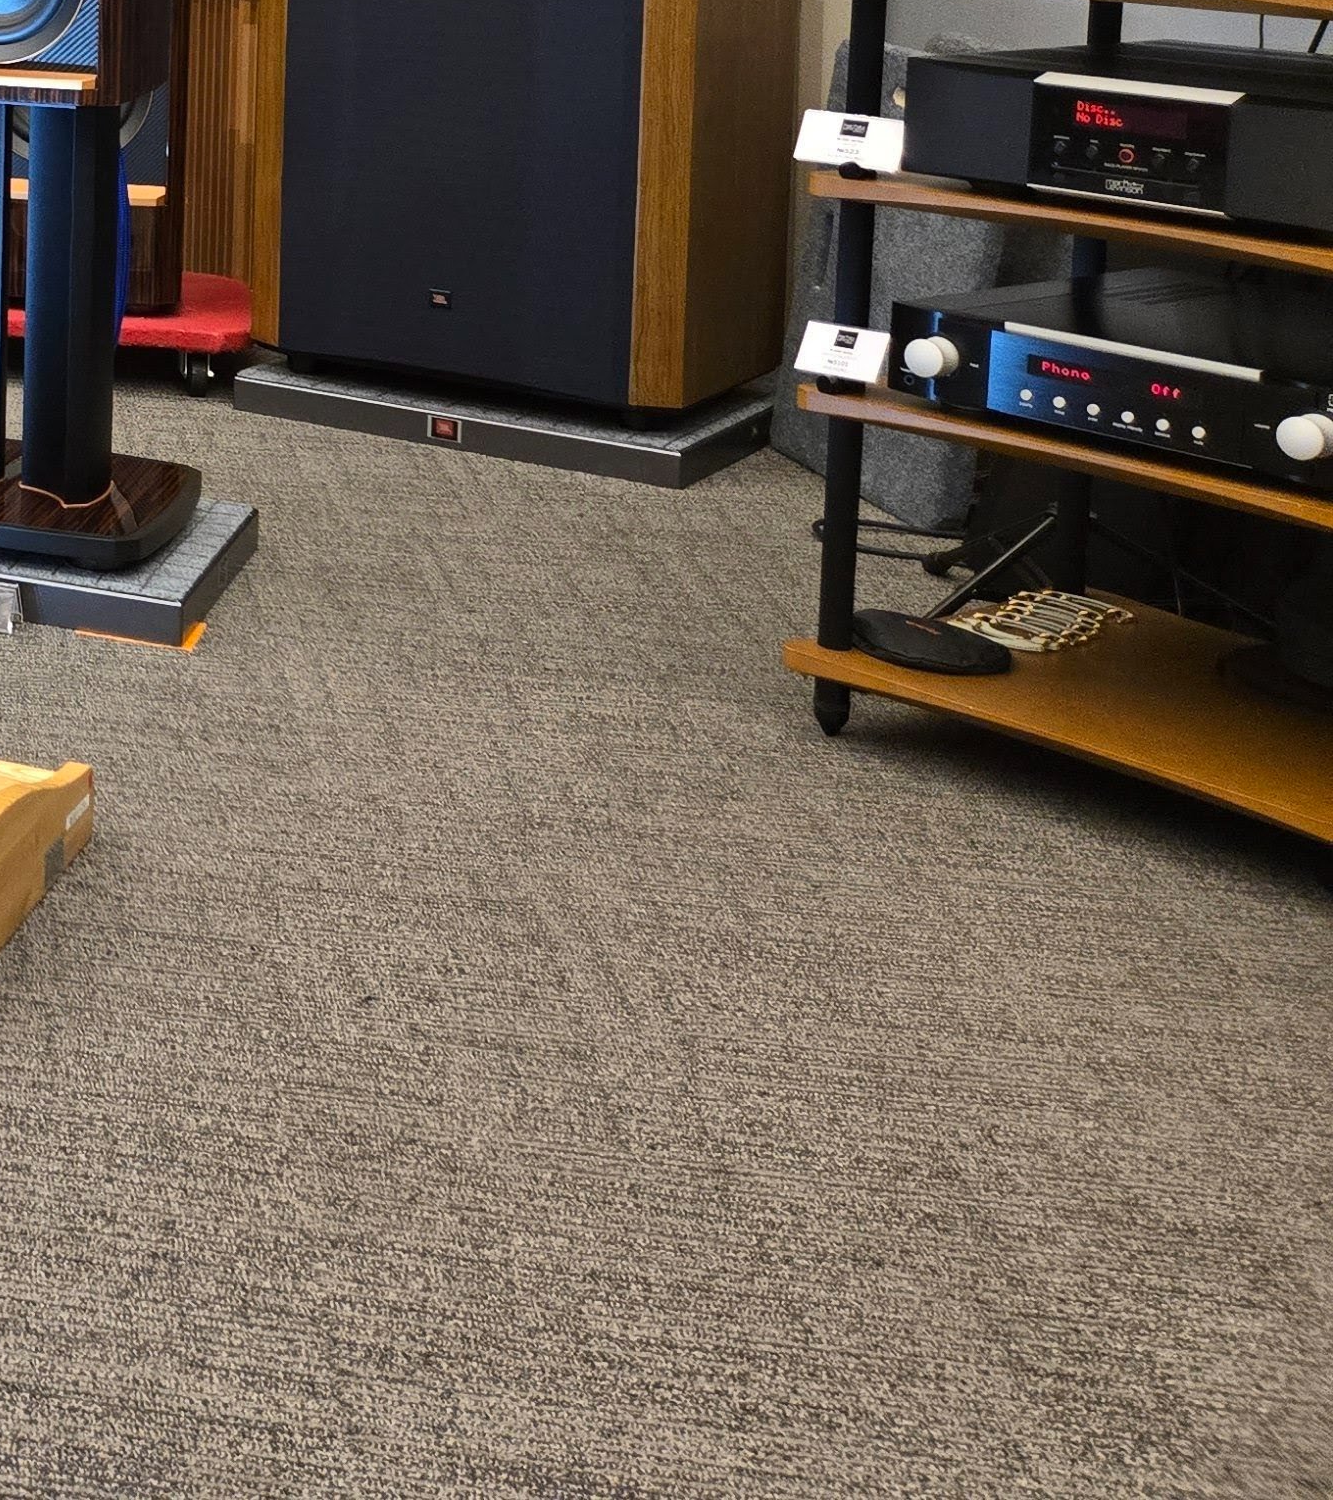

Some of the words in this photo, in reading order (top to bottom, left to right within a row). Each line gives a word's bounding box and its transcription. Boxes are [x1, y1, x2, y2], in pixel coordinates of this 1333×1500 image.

[1076, 112, 1091, 125] No
[1095, 115, 1124, 128] Disc
[1041, 361, 1090, 381] Phono
[1151, 383, 1181, 399] Off
